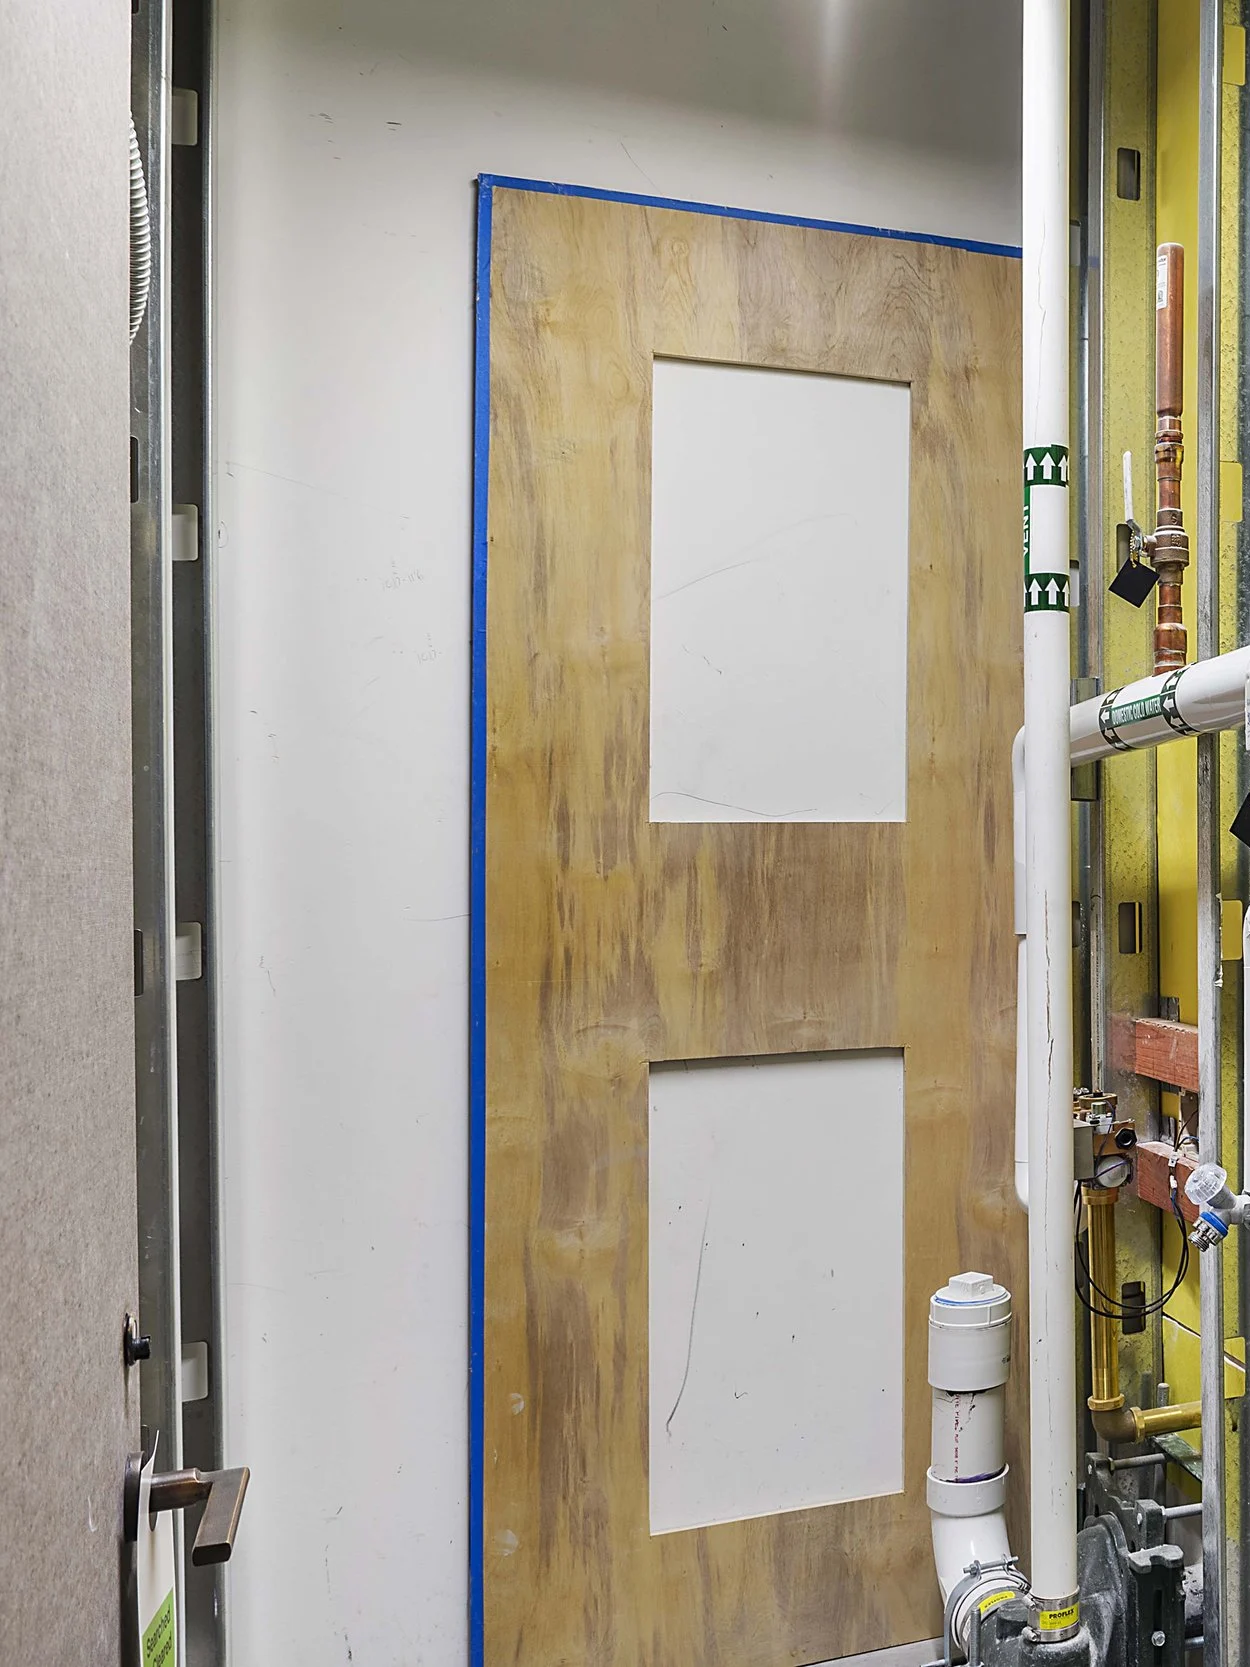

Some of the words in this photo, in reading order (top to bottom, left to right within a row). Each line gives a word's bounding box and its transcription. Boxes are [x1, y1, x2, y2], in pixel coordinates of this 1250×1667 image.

[1112, 704, 1133, 725] DOMESTIC
[1132, 701, 1146, 719] COLD
[1145, 696, 1161, 715] WATER
[1049, 1608, 1074, 1619] PROFLEX
[147, 1603, 171, 1658] Searched
